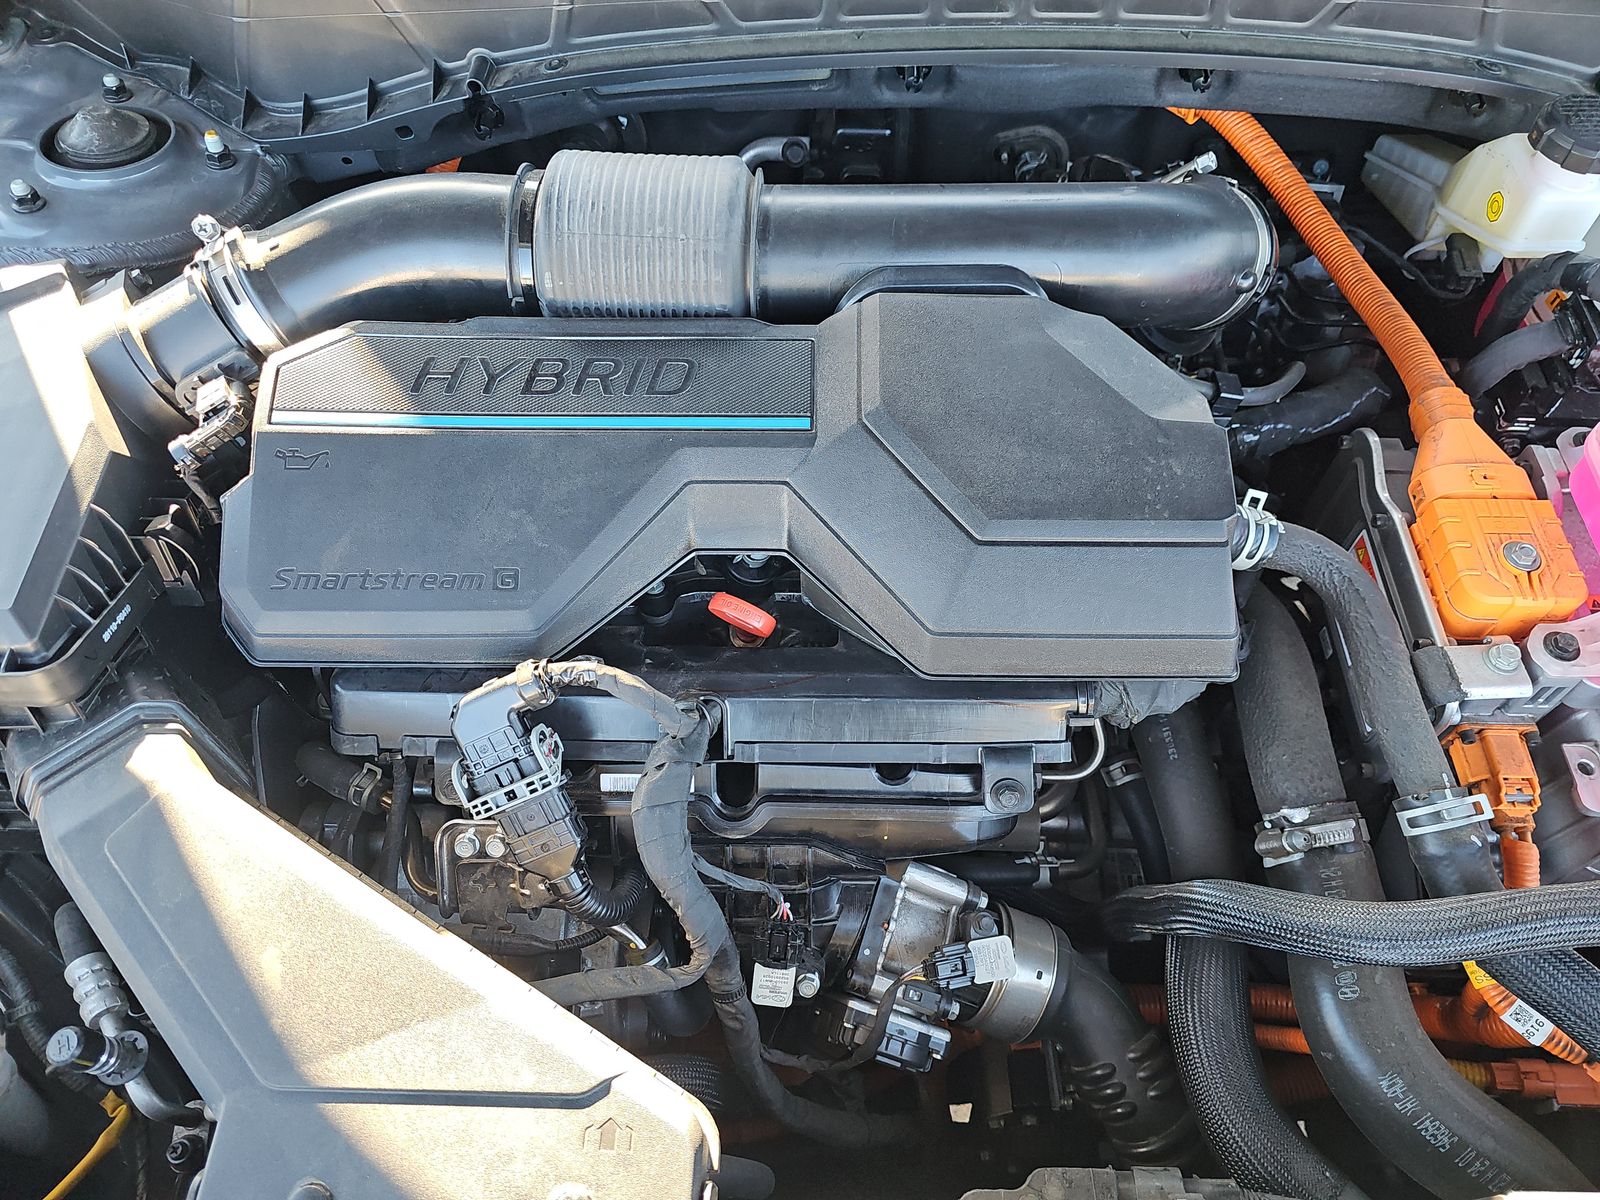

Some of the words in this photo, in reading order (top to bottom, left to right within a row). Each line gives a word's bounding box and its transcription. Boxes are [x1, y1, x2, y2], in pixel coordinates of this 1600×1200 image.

[409, 356, 699, 396] HYBRID
[270, 566, 487, 591] Smartstream
[493, 566, 520, 591] G
[721, 598, 733, 607] OIL
[733, 604, 763, 625] ENGINE
[57, 1035, 71, 1055] H
[1454, 1147, 1476, 1167] 01
[1467, 1157, 1490, 1177] 24
